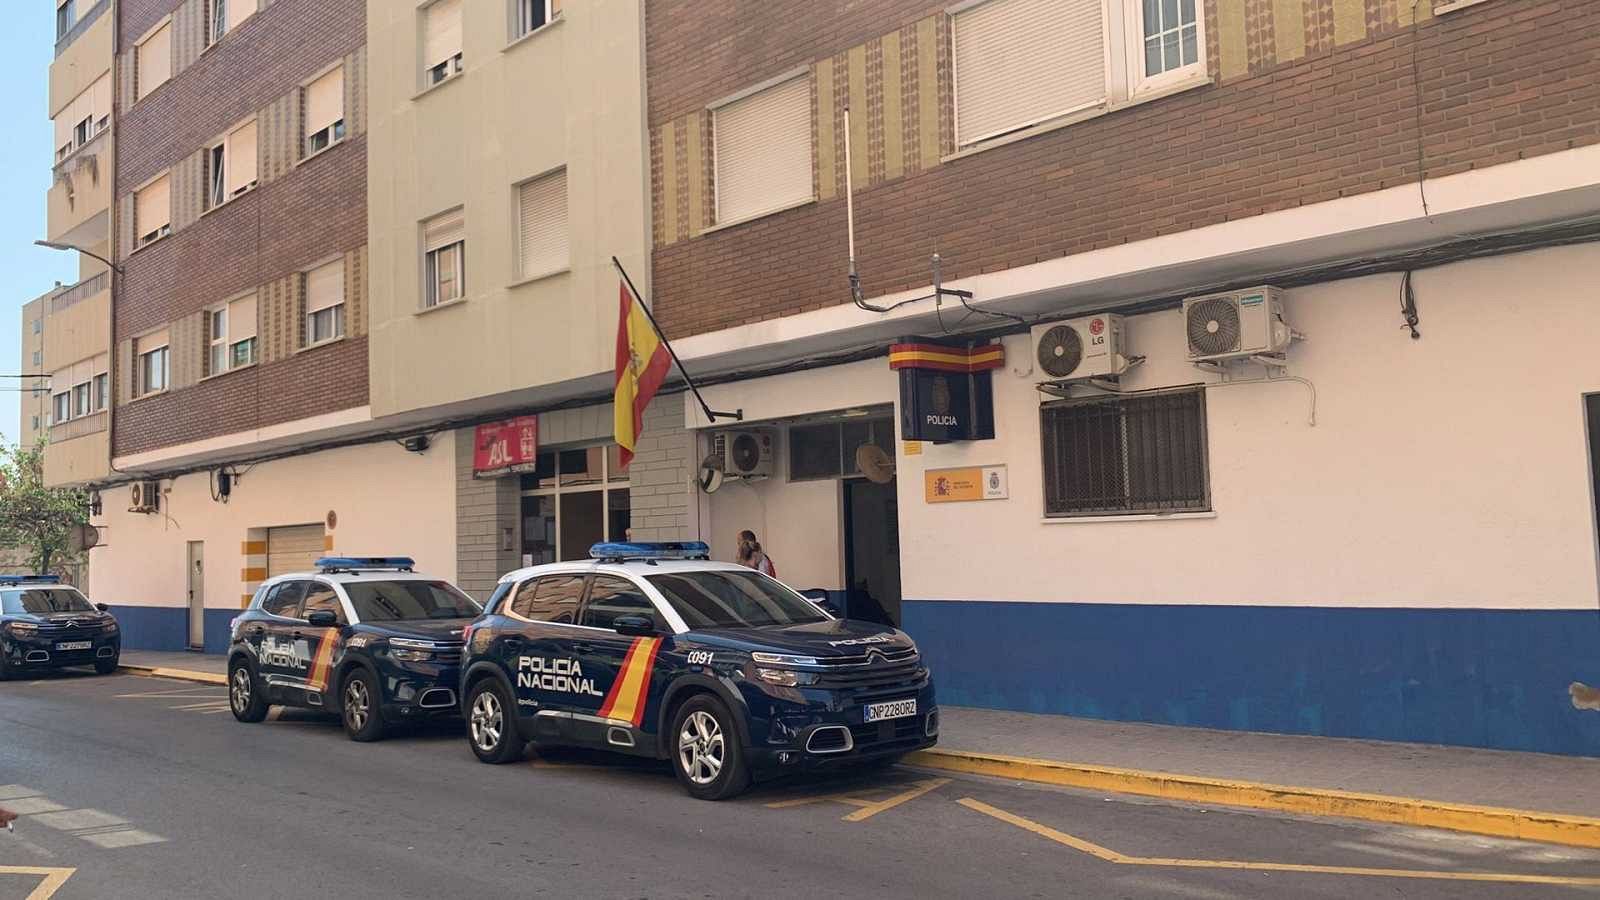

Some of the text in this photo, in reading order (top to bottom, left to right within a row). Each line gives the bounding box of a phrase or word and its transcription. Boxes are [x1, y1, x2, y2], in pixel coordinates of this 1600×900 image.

[1092, 336, 1104, 345] LG
[927, 415, 957, 425] POLICIA
[518, 673, 603, 696] NACIONAL
